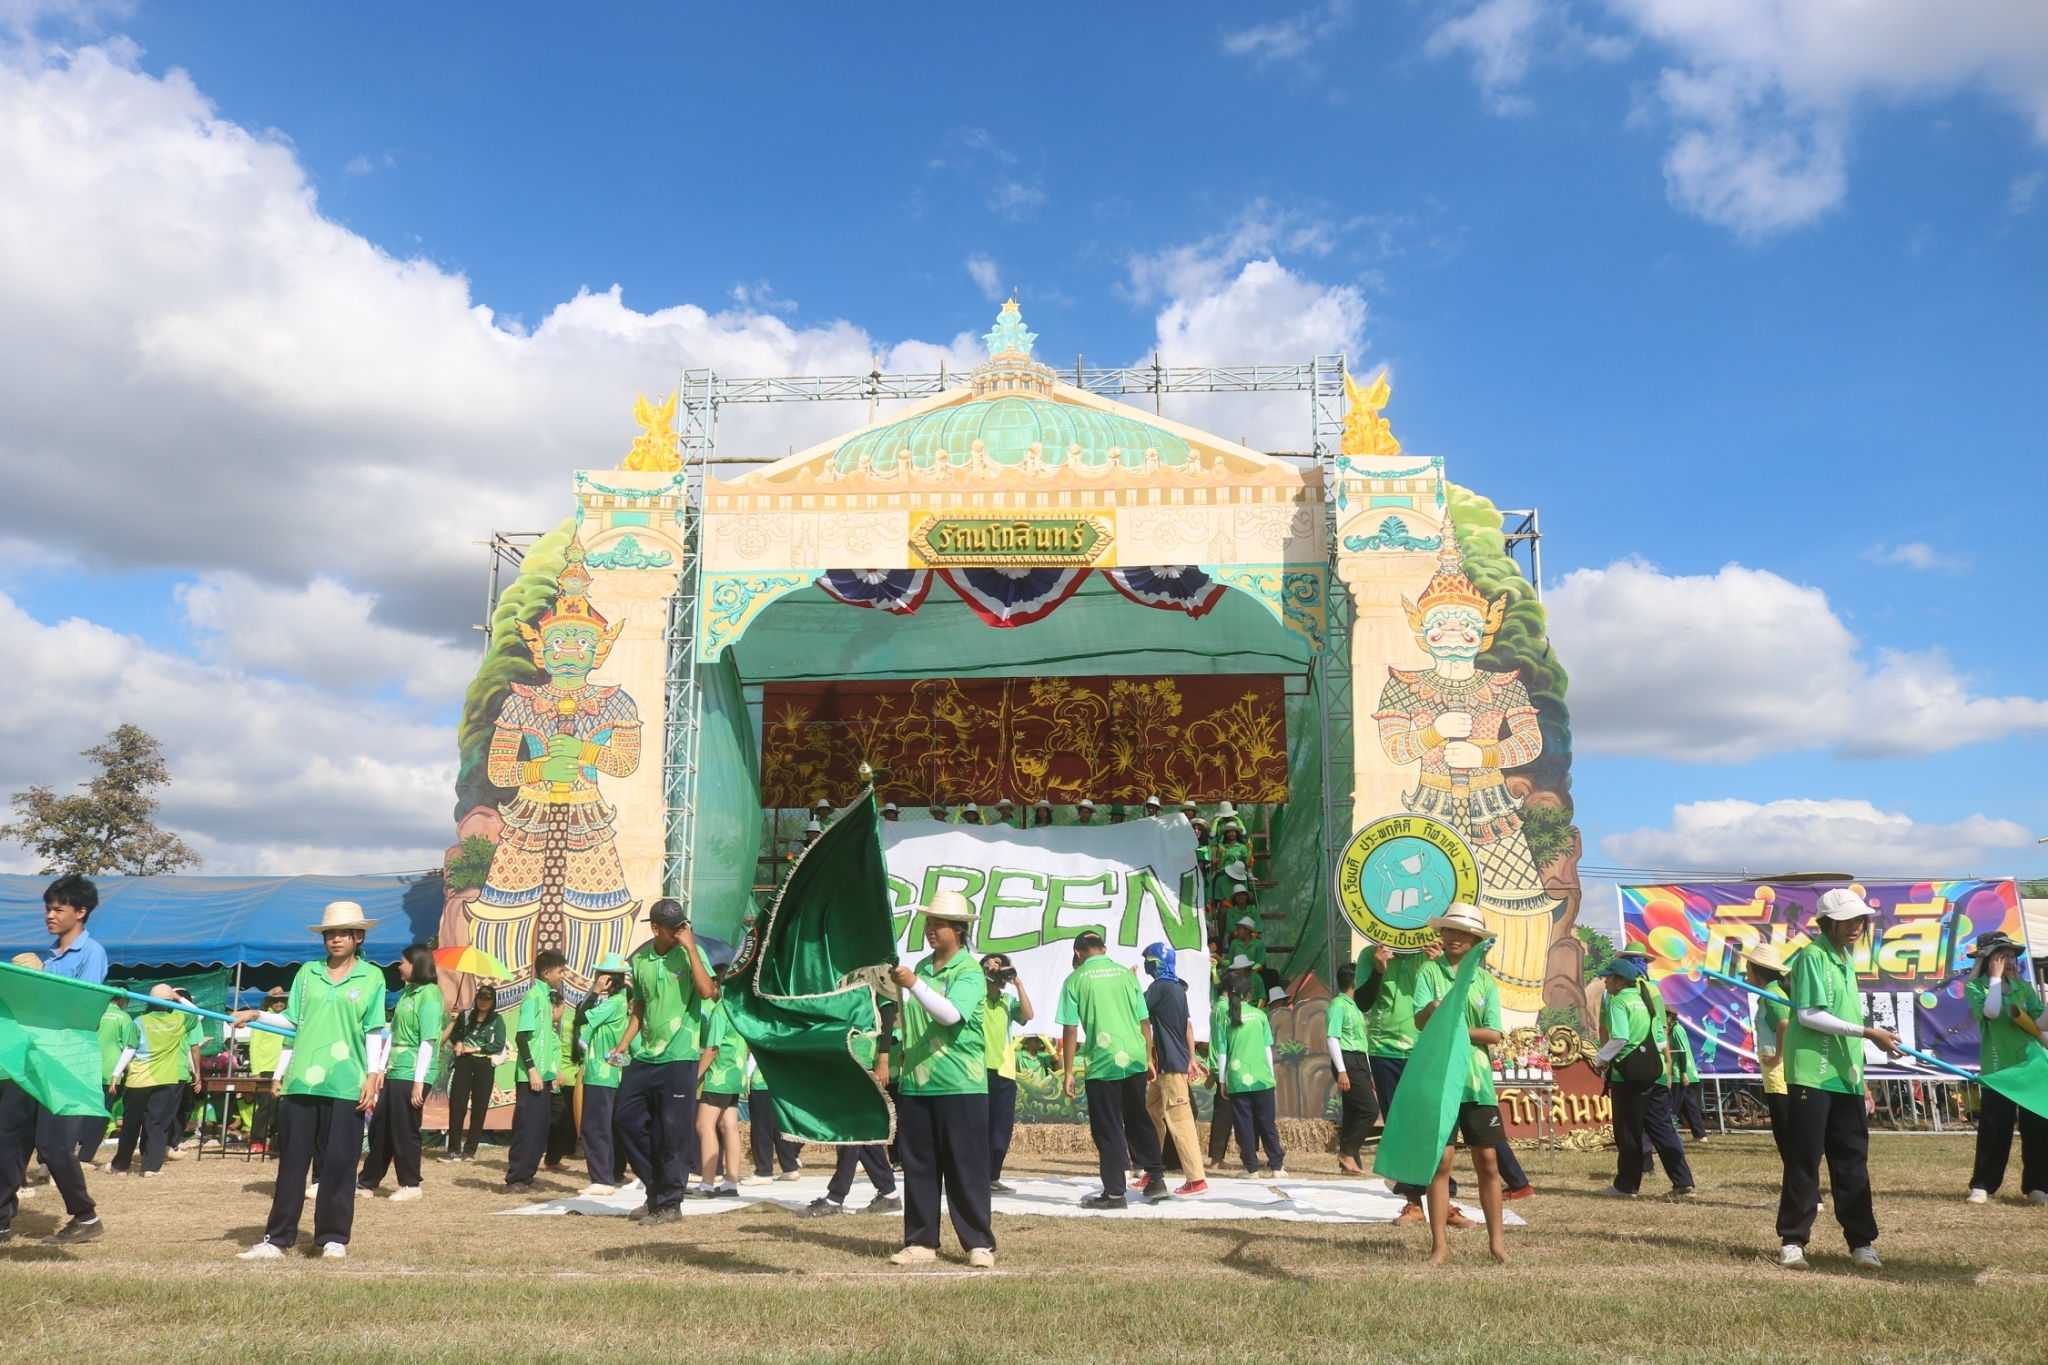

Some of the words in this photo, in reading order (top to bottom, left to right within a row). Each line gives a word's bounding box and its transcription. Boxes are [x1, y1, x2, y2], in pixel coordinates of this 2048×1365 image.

[939, 521, 1086, 550] รัตนโกสินทร์
